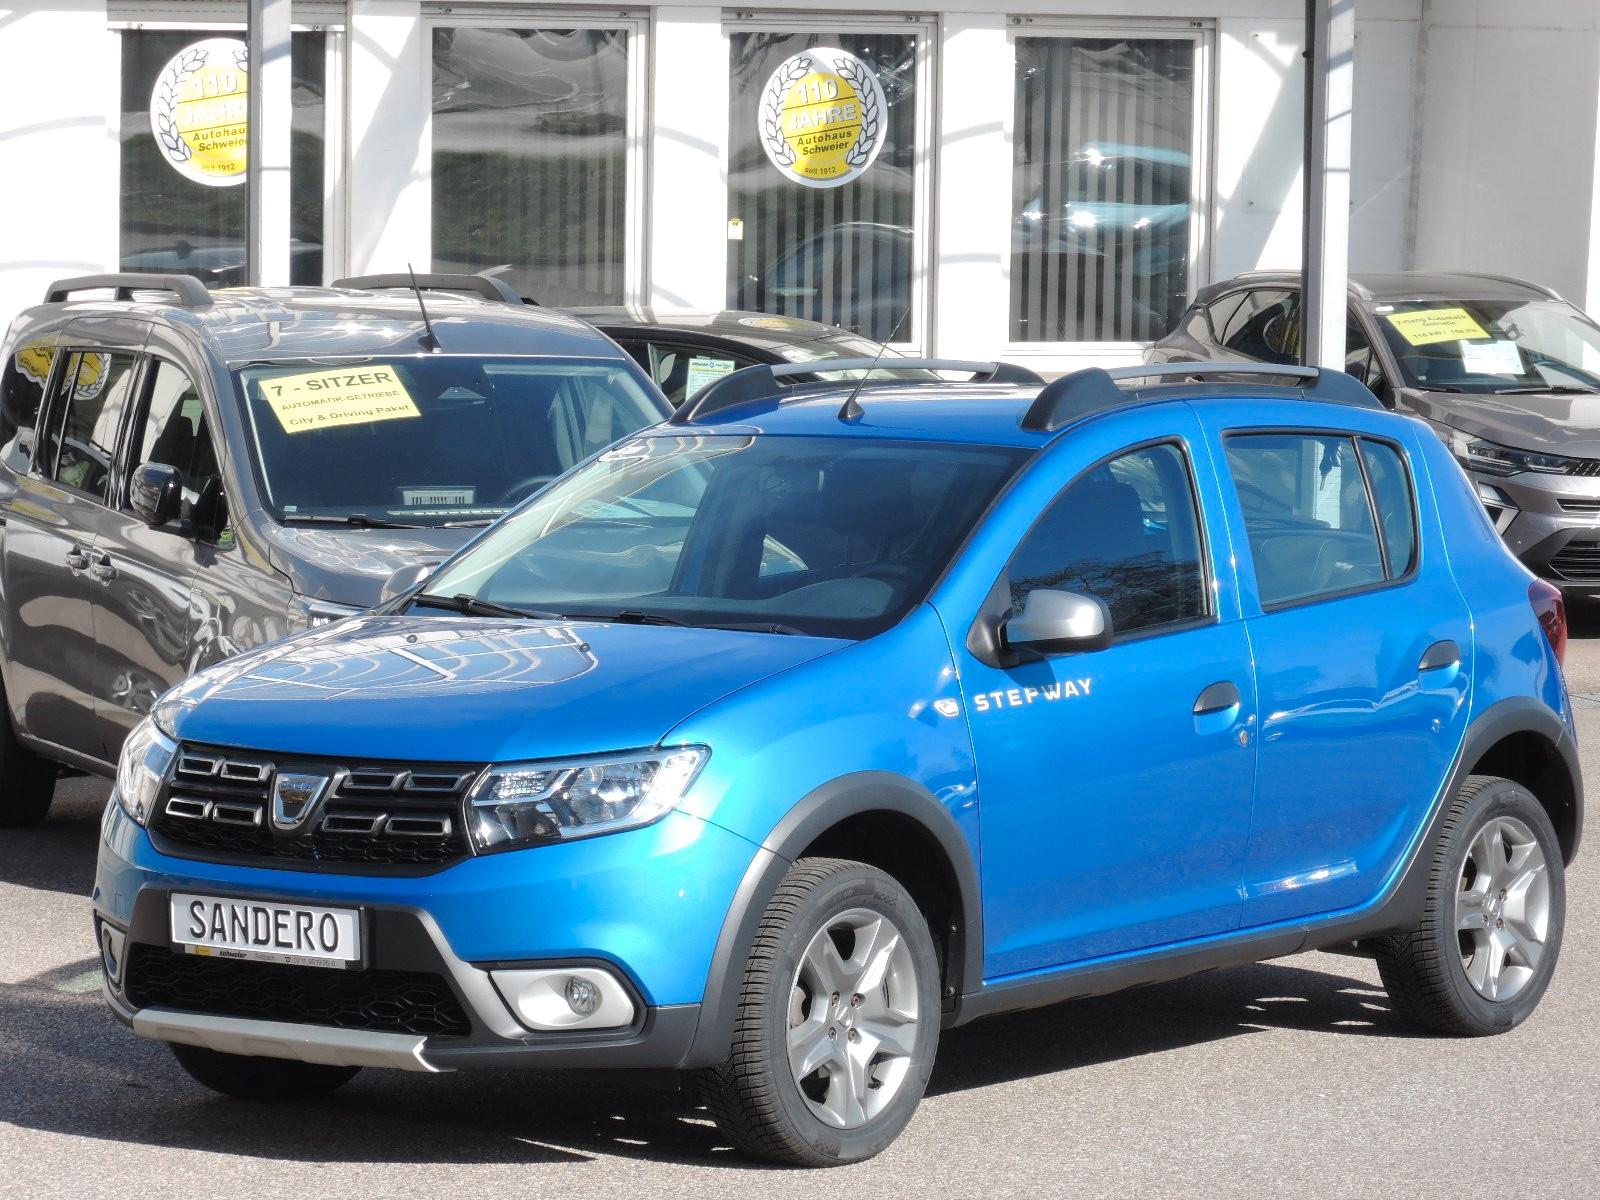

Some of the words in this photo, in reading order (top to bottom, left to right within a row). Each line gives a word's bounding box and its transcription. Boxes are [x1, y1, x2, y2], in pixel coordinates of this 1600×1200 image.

[190, 72, 239, 98] 110
[797, 78, 838, 104] 110
[181, 100, 247, 125] JAHR
[790, 103, 858, 131] JAHRE
[193, 127, 246, 141] Autohau
[797, 129, 852, 146] Autohaus
[802, 140, 850, 156] Schweier
[218, 163, 236, 172] 1912
[820, 166, 837, 175] 1912
[271, 385, 284, 397] 7
[306, 372, 393, 392] SITZER
[281, 390, 401, 411] AUTOMATIK-GETRIEBE
[289, 417, 314, 427] City
[318, 413, 327, 421] &
[329, 408, 374, 419] Driving
[375, 404, 410, 414] Paket
[973, 678, 1092, 712] STEPWAY
[189, 900, 340, 953] SANDERO
